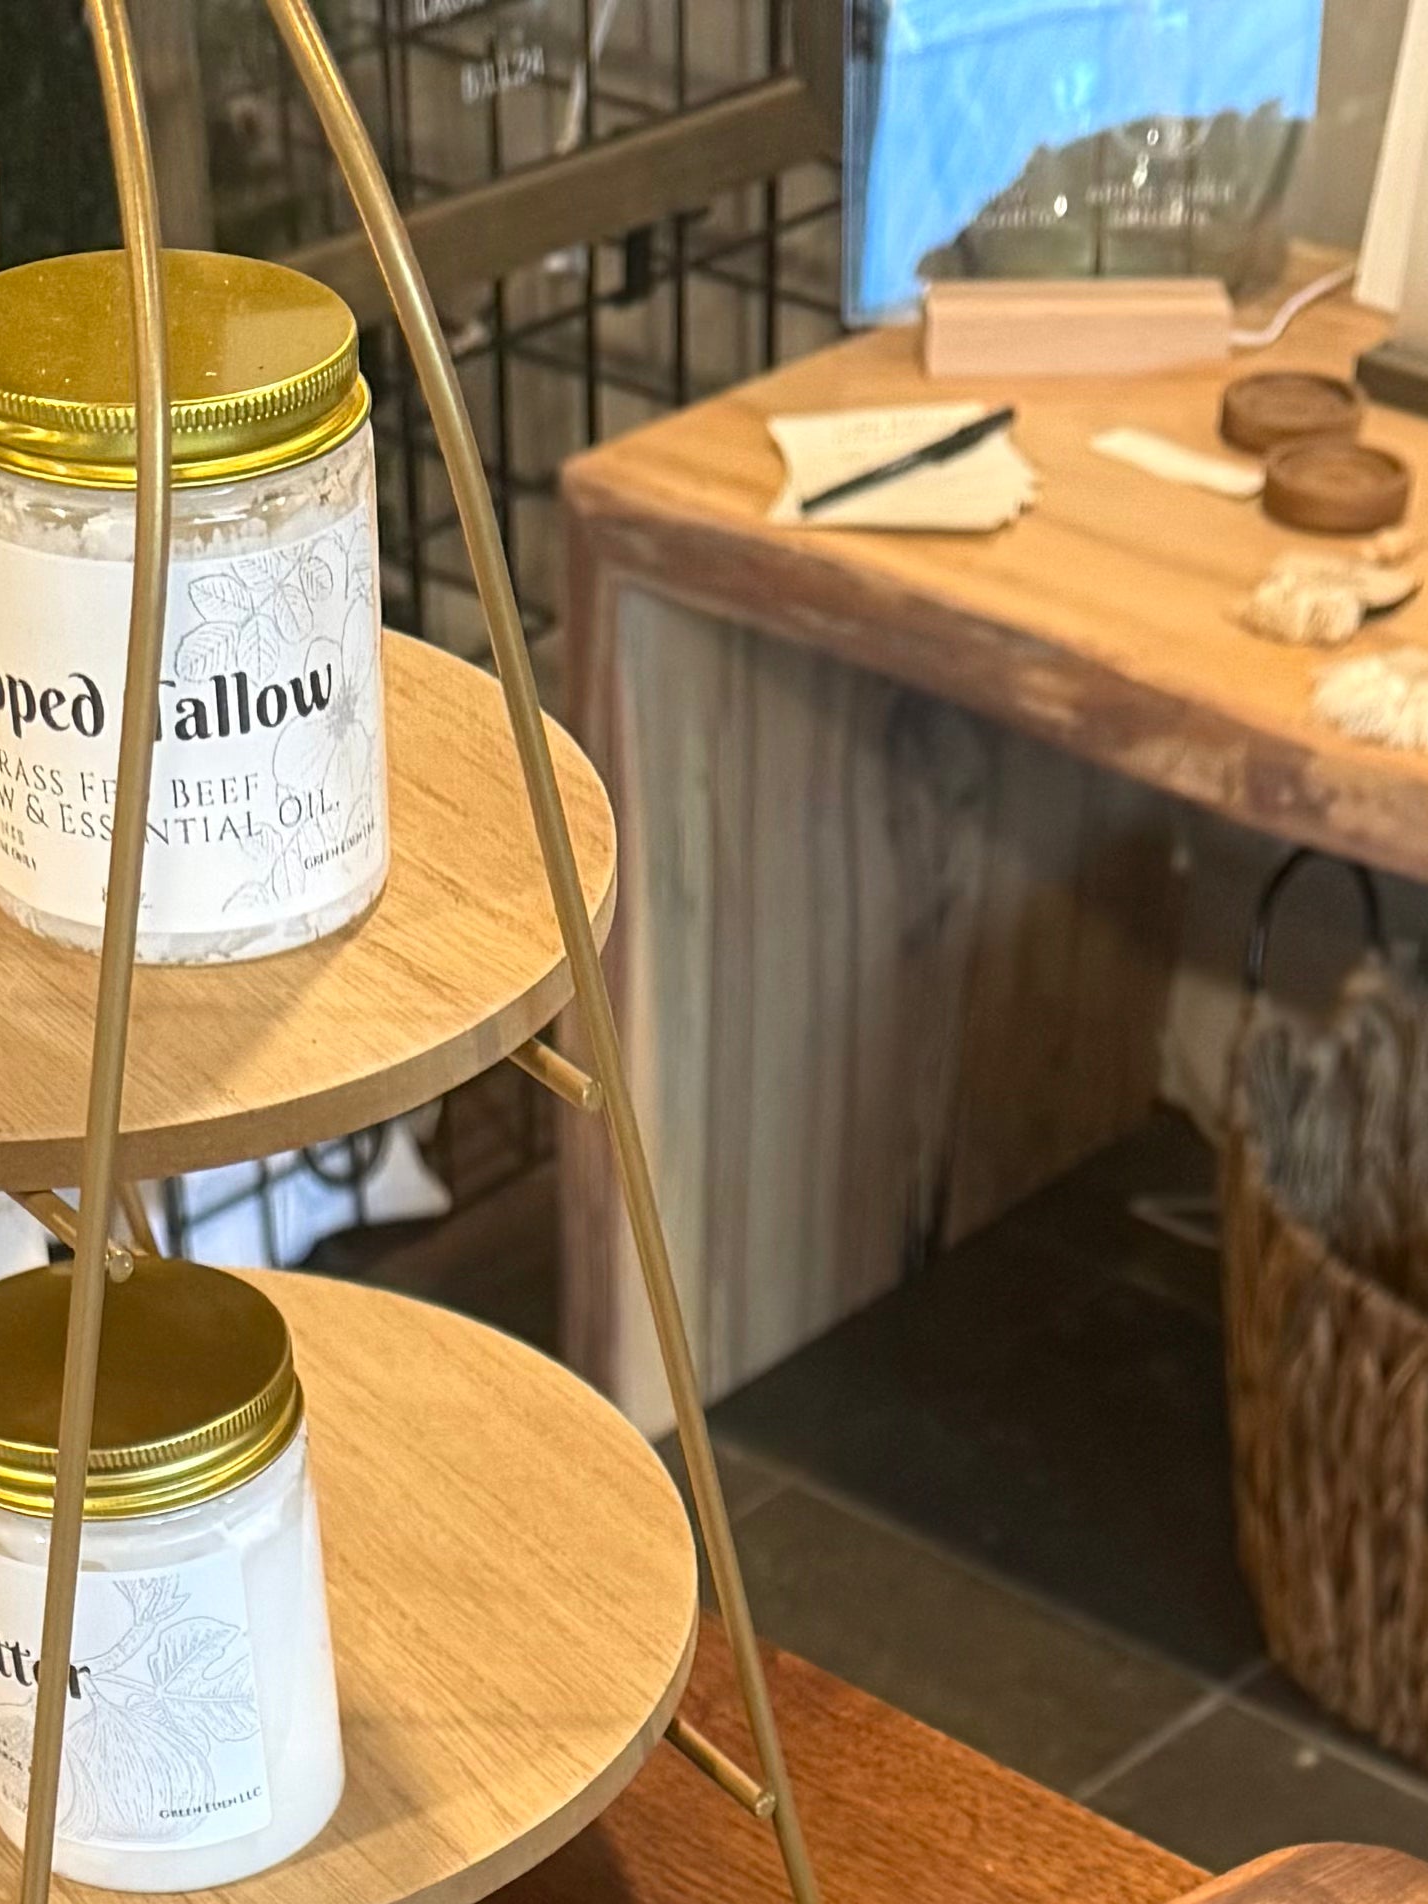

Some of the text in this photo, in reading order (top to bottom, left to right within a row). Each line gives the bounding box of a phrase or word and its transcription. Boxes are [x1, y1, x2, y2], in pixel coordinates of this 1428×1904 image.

[171, 772, 259, 809] BEEF
[26, 793, 49, 829] &
[60, 803, 263, 846] ESSNTIAL
